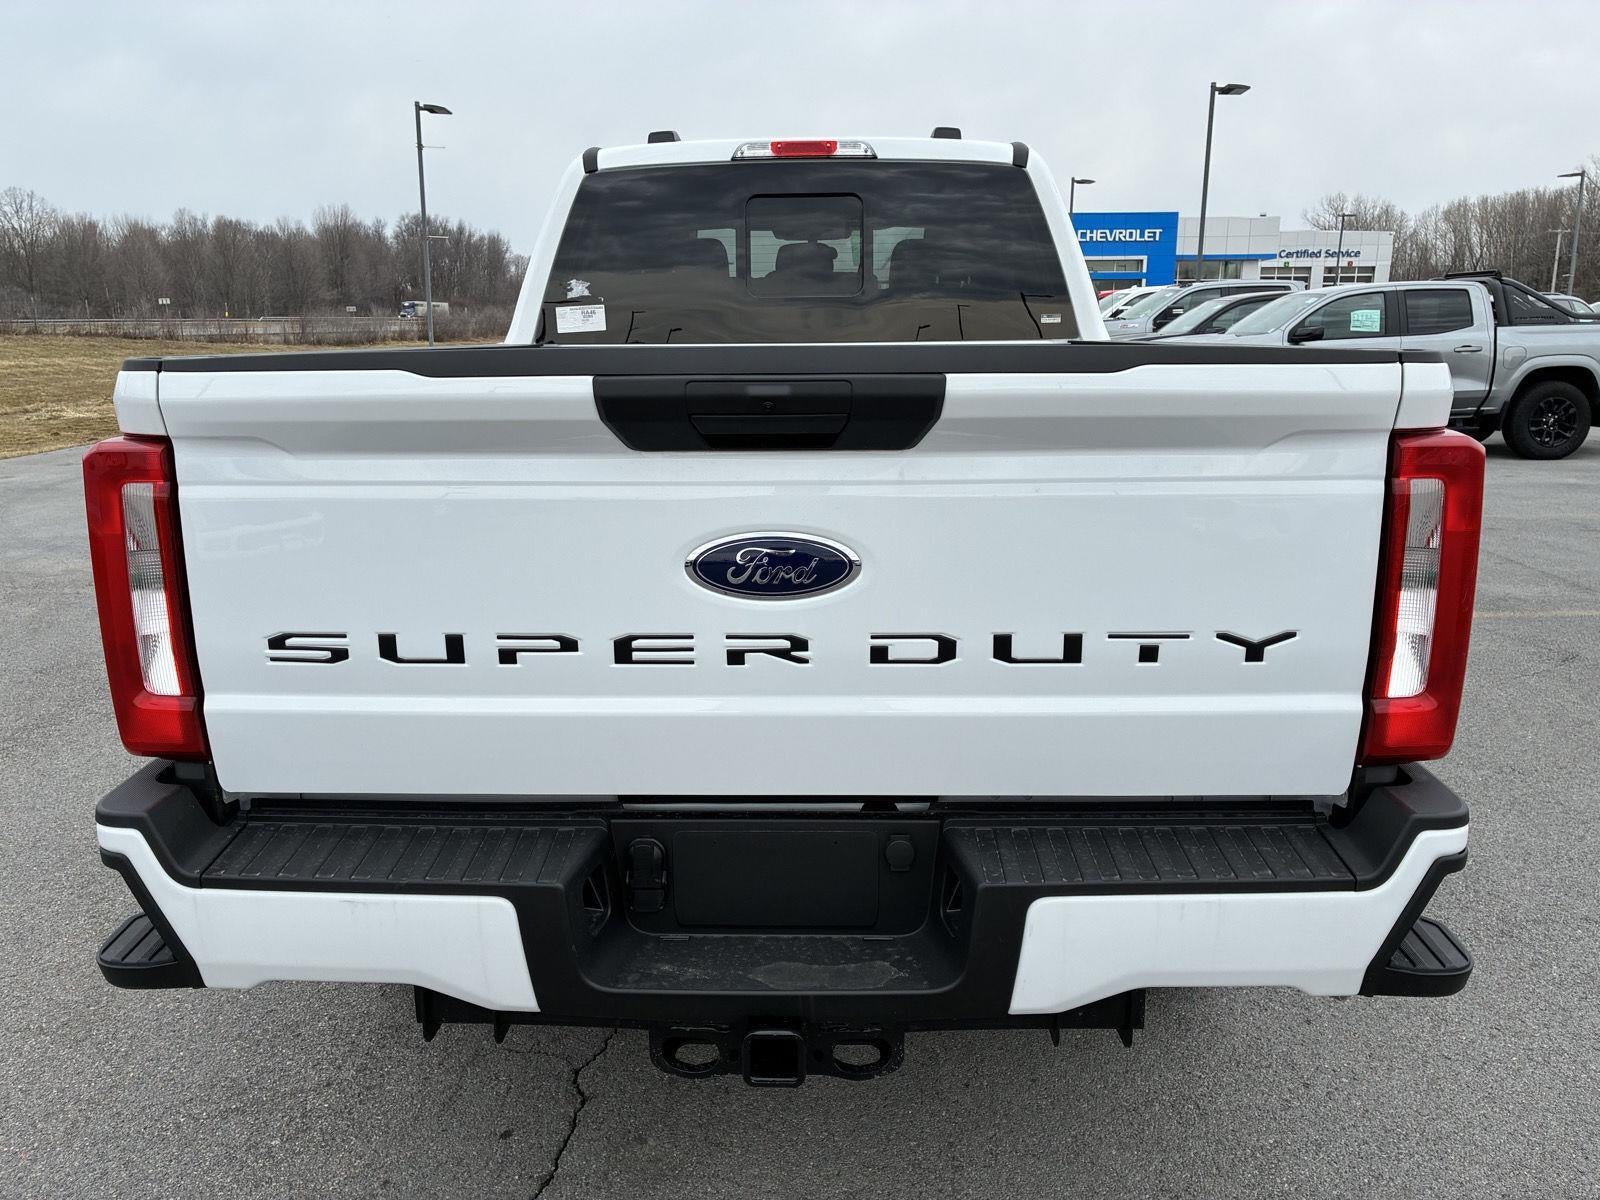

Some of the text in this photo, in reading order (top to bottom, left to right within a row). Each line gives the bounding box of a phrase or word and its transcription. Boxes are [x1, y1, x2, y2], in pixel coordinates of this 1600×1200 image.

[1077, 229, 1163, 242] CHEVROLET
[1279, 249, 1322, 259] Certified
[727, 547, 820, 585] Ford
[265, 630, 1300, 667] SUPER DUTY
